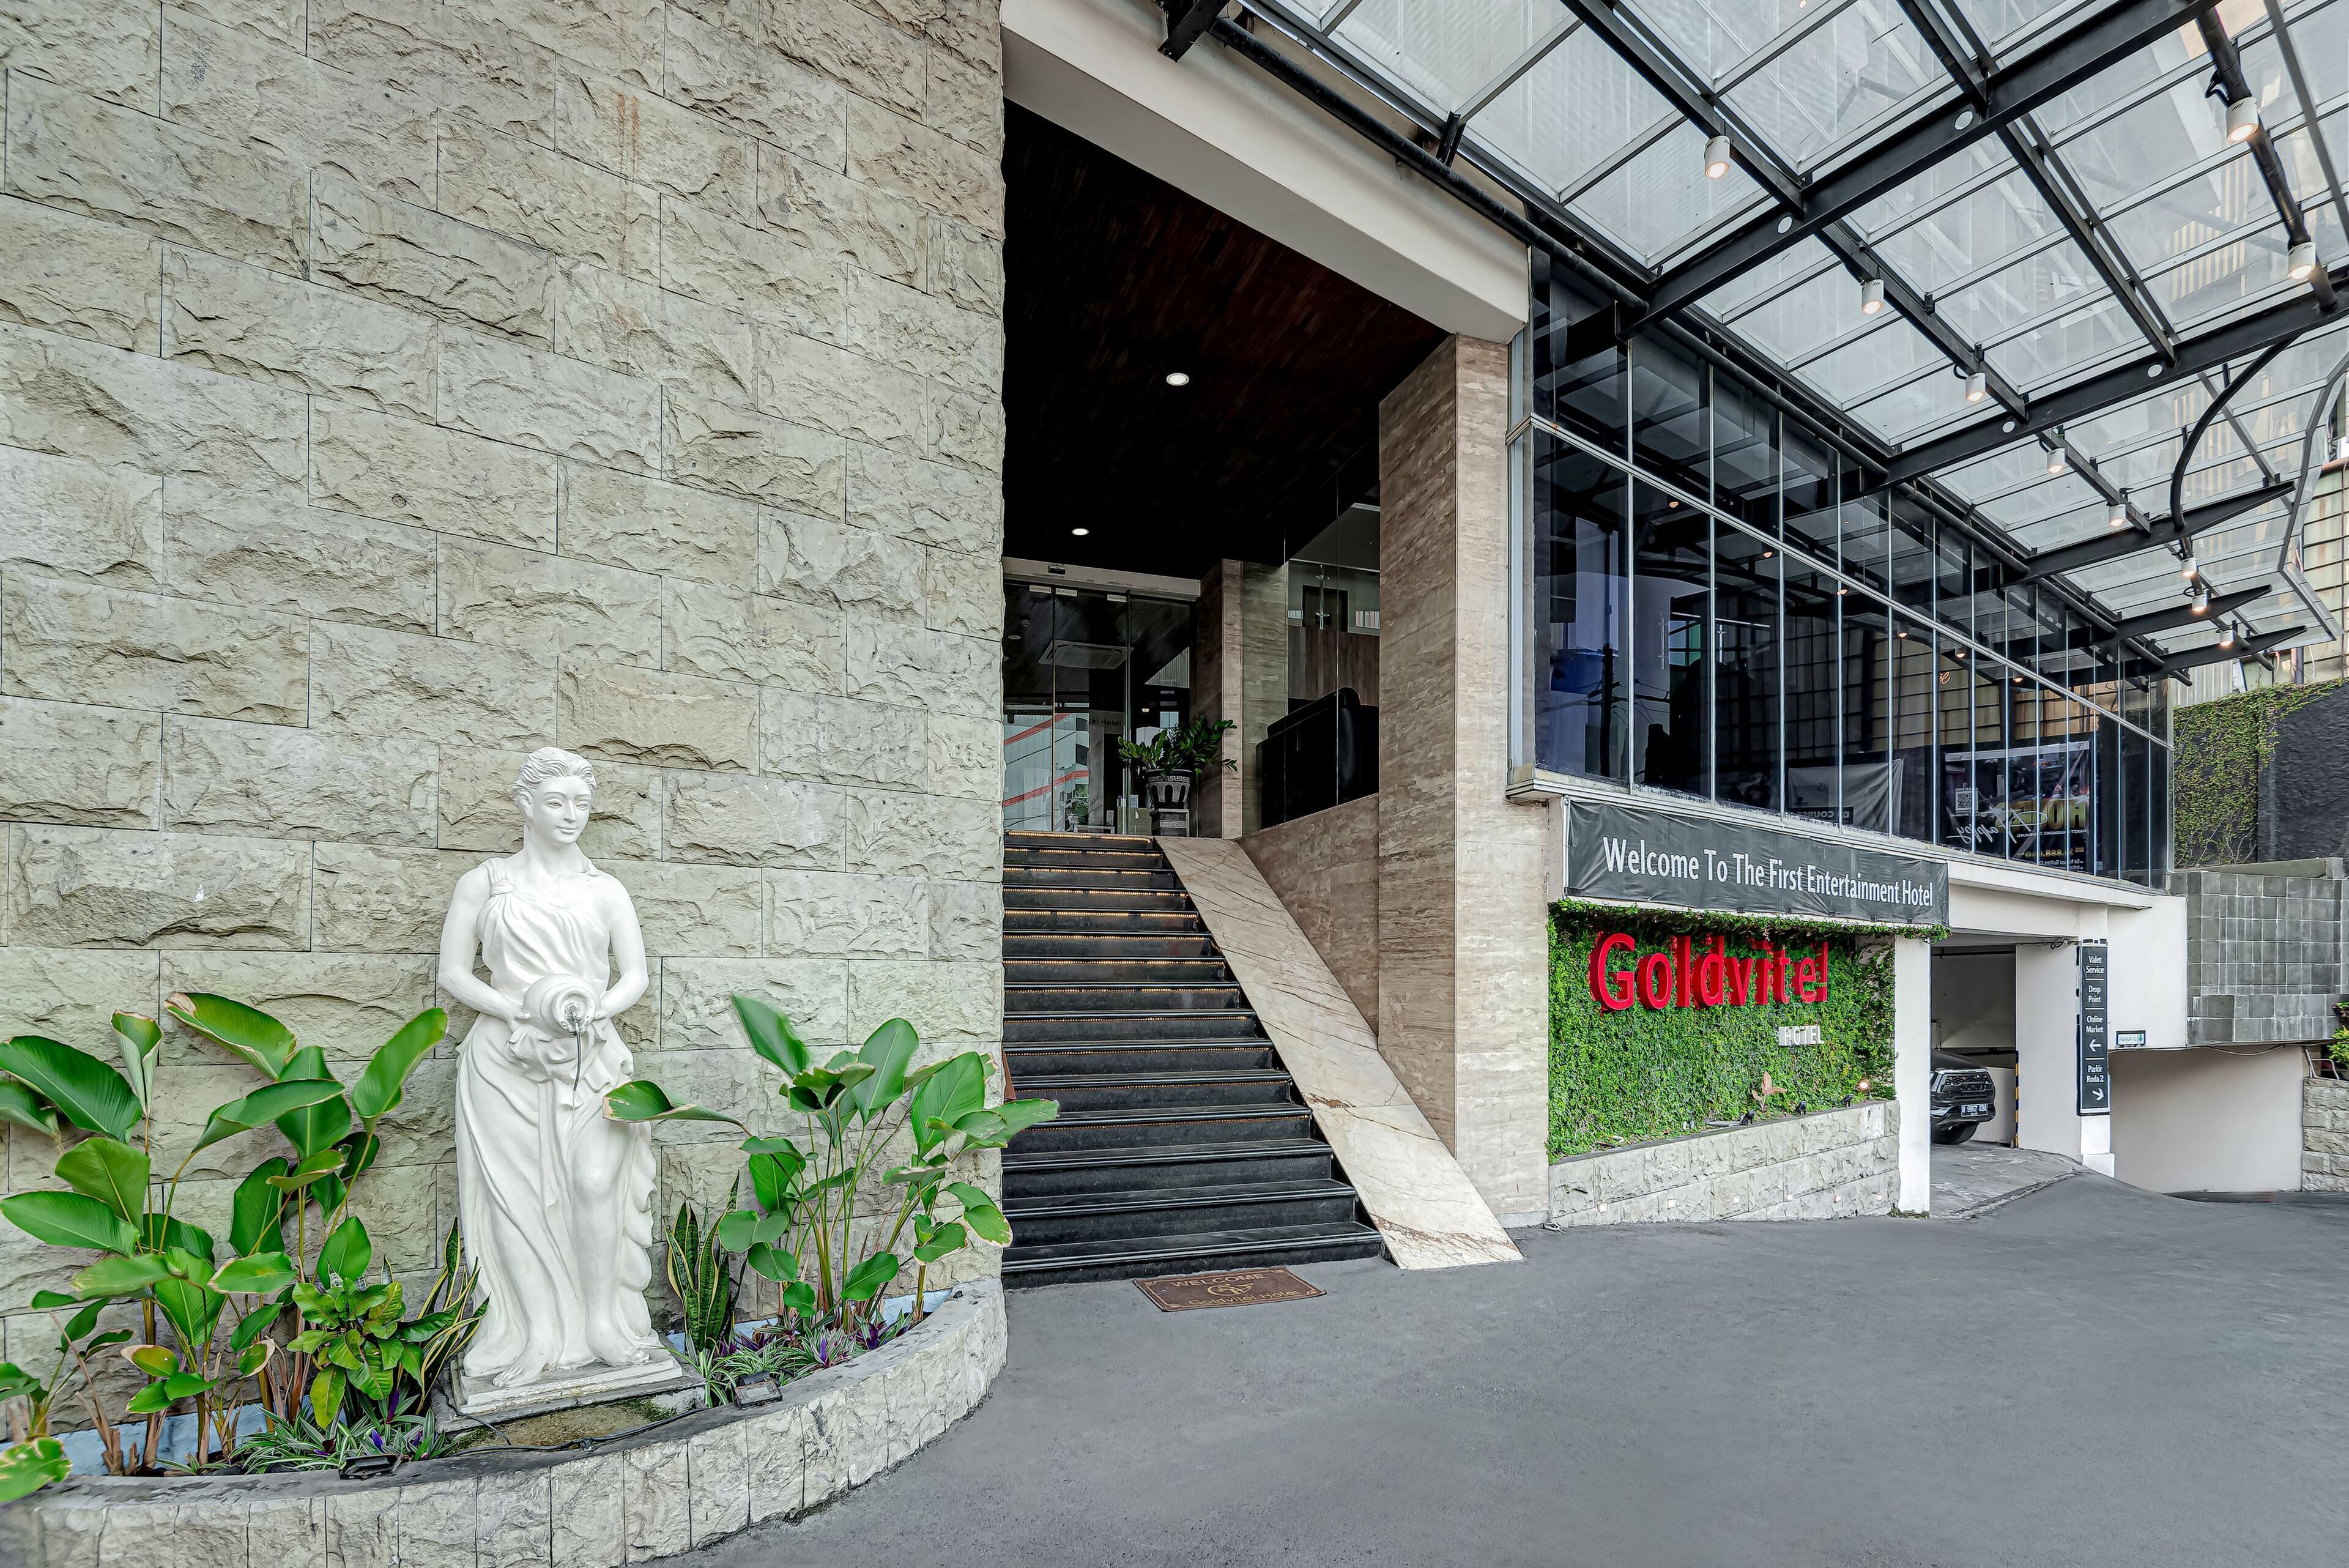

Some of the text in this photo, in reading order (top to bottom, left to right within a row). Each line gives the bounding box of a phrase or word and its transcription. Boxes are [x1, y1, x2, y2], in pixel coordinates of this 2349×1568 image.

[1602, 836, 1934, 907] Welcome To The First Entertainment Hotel
[1589, 932, 1828, 1011] Goldvitel
[2088, 985, 2101, 994] Drop
[1781, 1026, 1824, 1046] HOTEL
[1171, 1273, 1267, 1287] WELCOME
